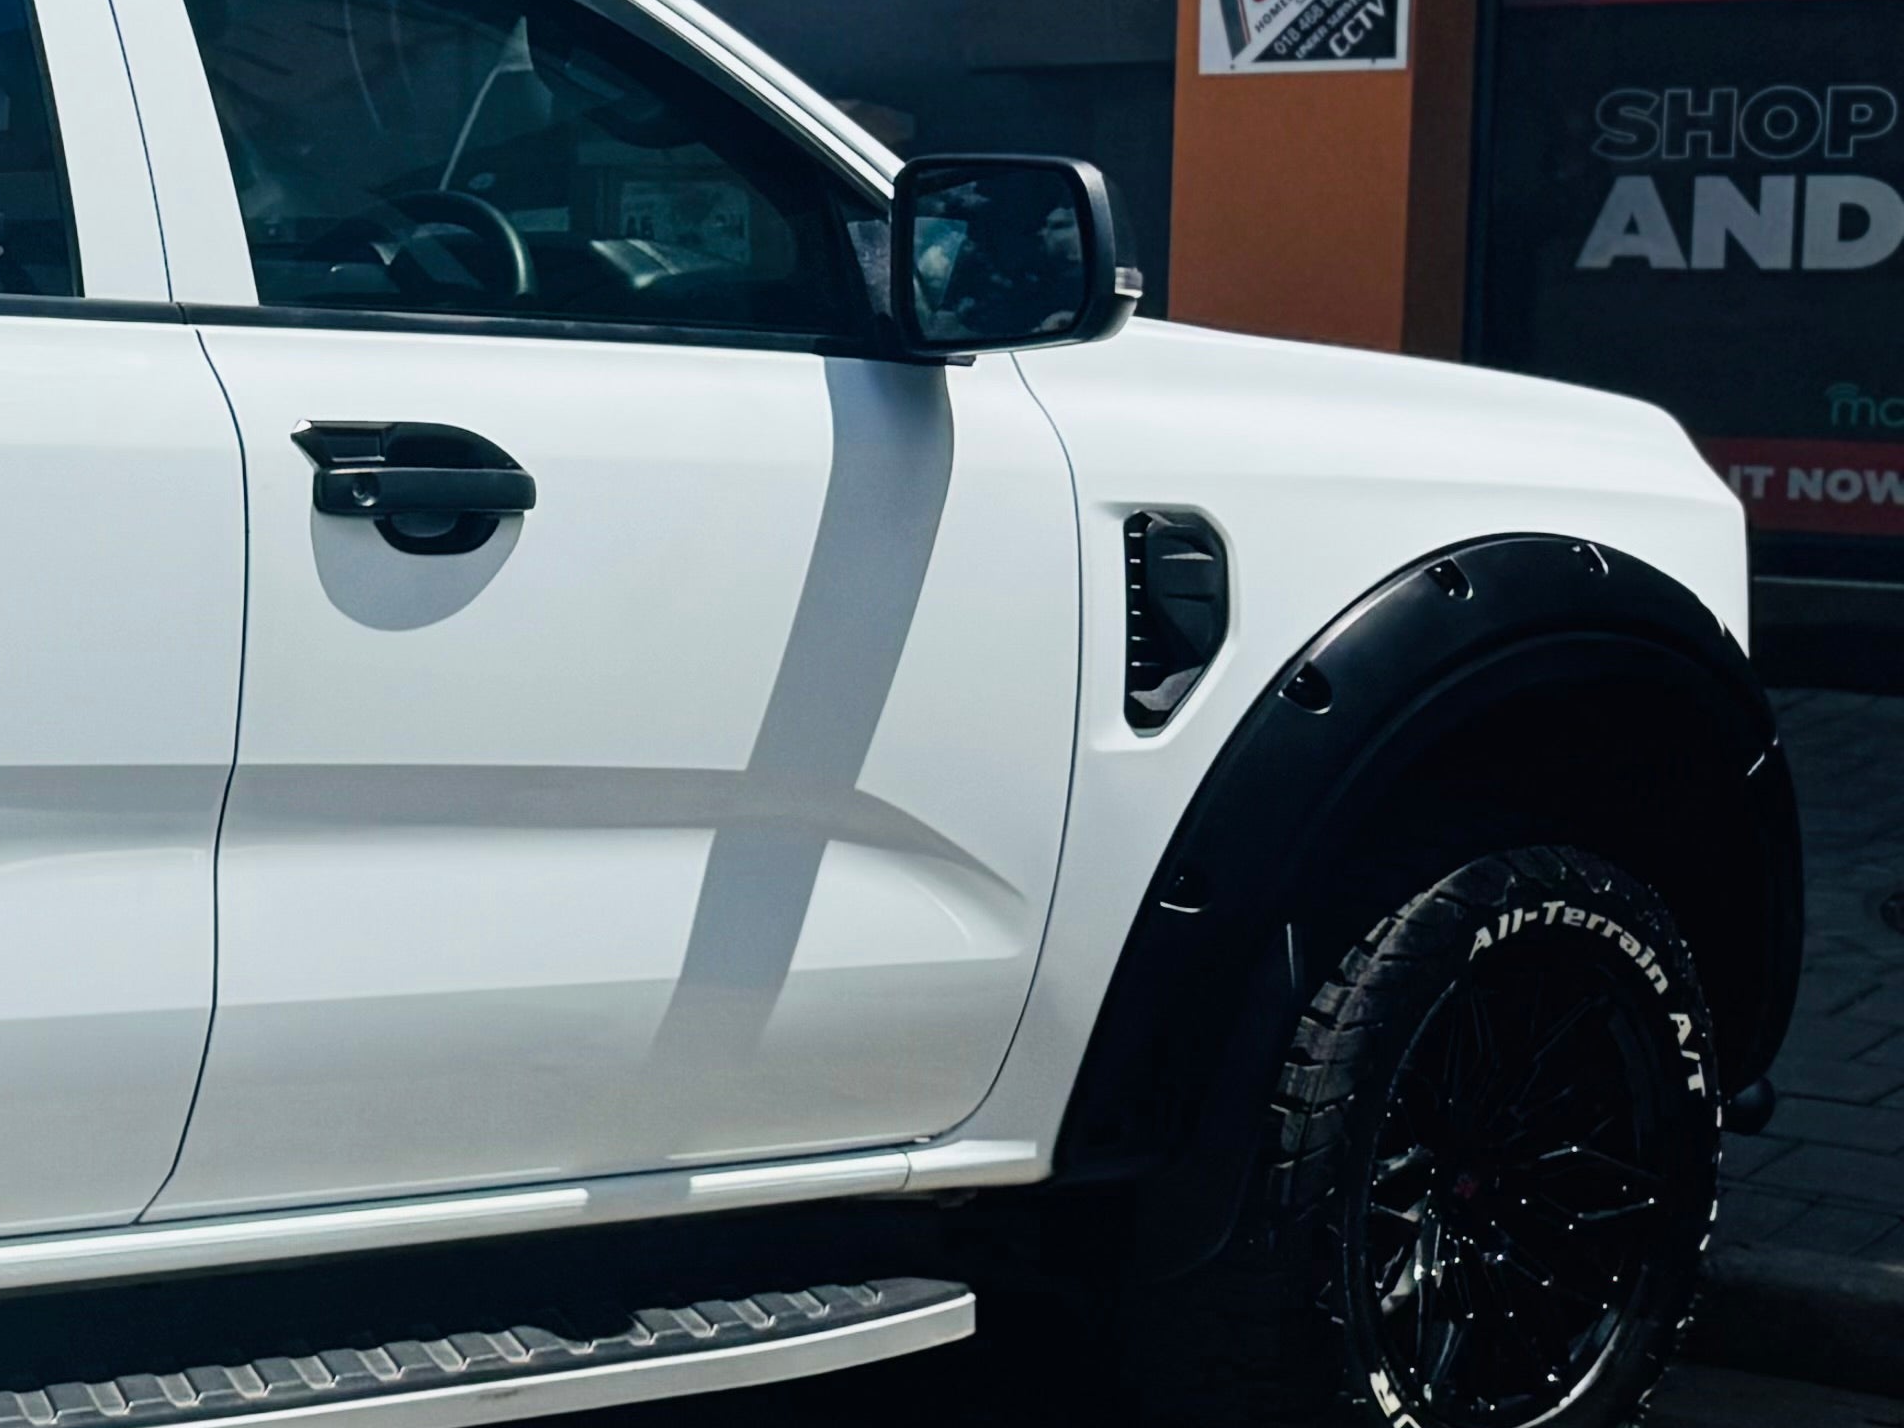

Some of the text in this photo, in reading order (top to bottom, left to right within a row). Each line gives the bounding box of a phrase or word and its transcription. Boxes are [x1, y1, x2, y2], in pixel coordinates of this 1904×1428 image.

[1274, 27, 1301, 55] 018
[1591, 84, 1898, 161] SHOP
[1574, 174, 1904, 270] AND
[1787, 468, 1904, 504] NOW
[1468, 899, 1706, 1097] All-Terrain A/T
